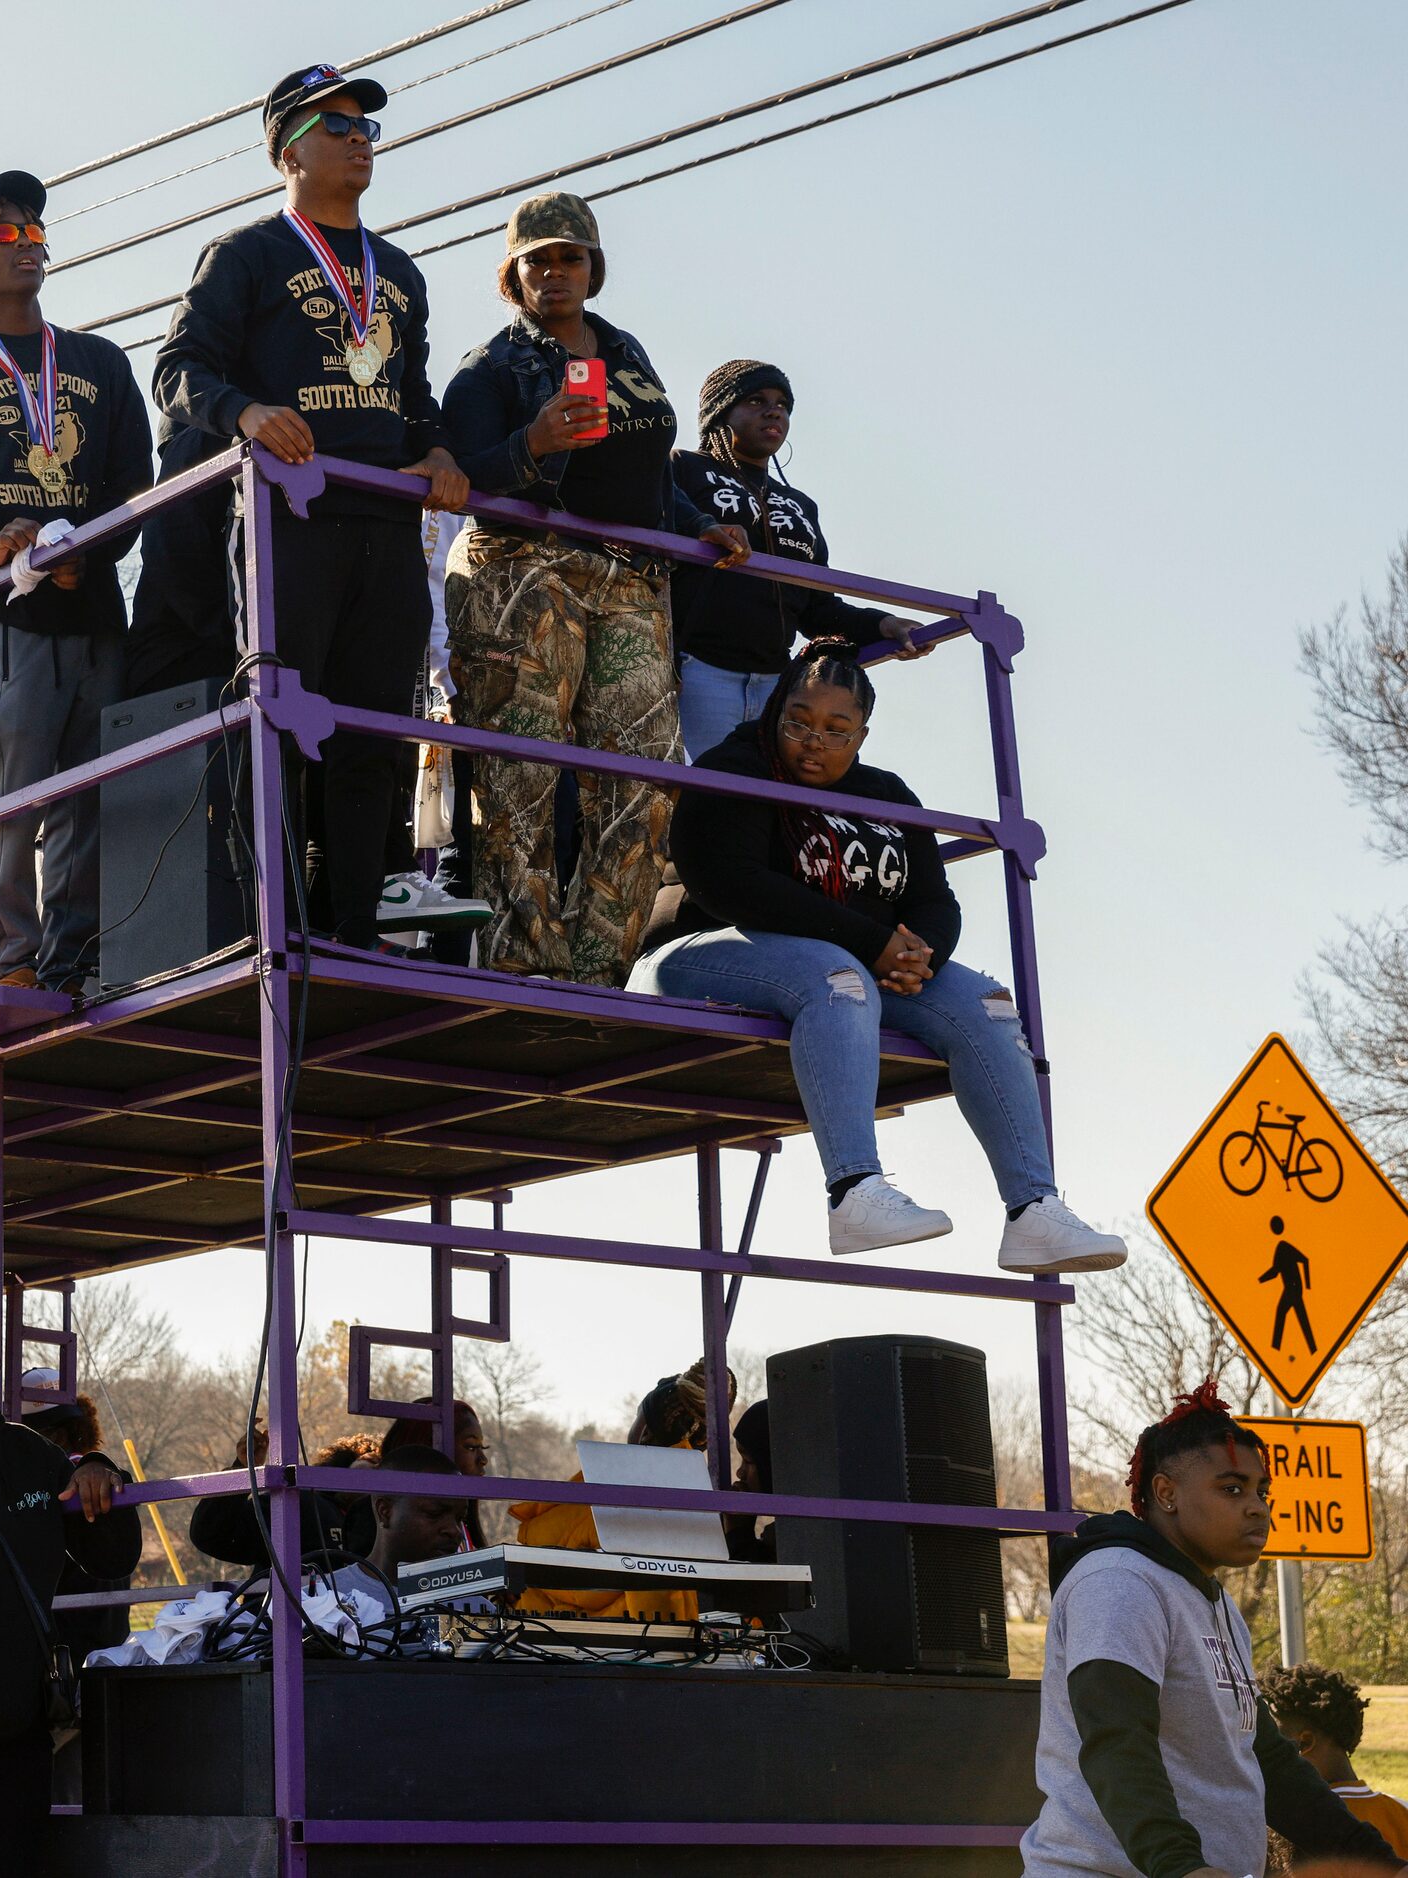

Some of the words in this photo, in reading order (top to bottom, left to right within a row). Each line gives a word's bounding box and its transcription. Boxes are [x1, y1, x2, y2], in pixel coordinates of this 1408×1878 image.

[286, 267, 330, 299] STAT
[342, 266, 409, 313] HAPIONS
[323, 356, 349, 366] DALLA
[24, 373, 98, 404] HPIONS
[298, 385, 357, 412] SOUTH
[608, 417, 655, 433] NTRY
[1268, 1444, 1343, 1479] RAIL
